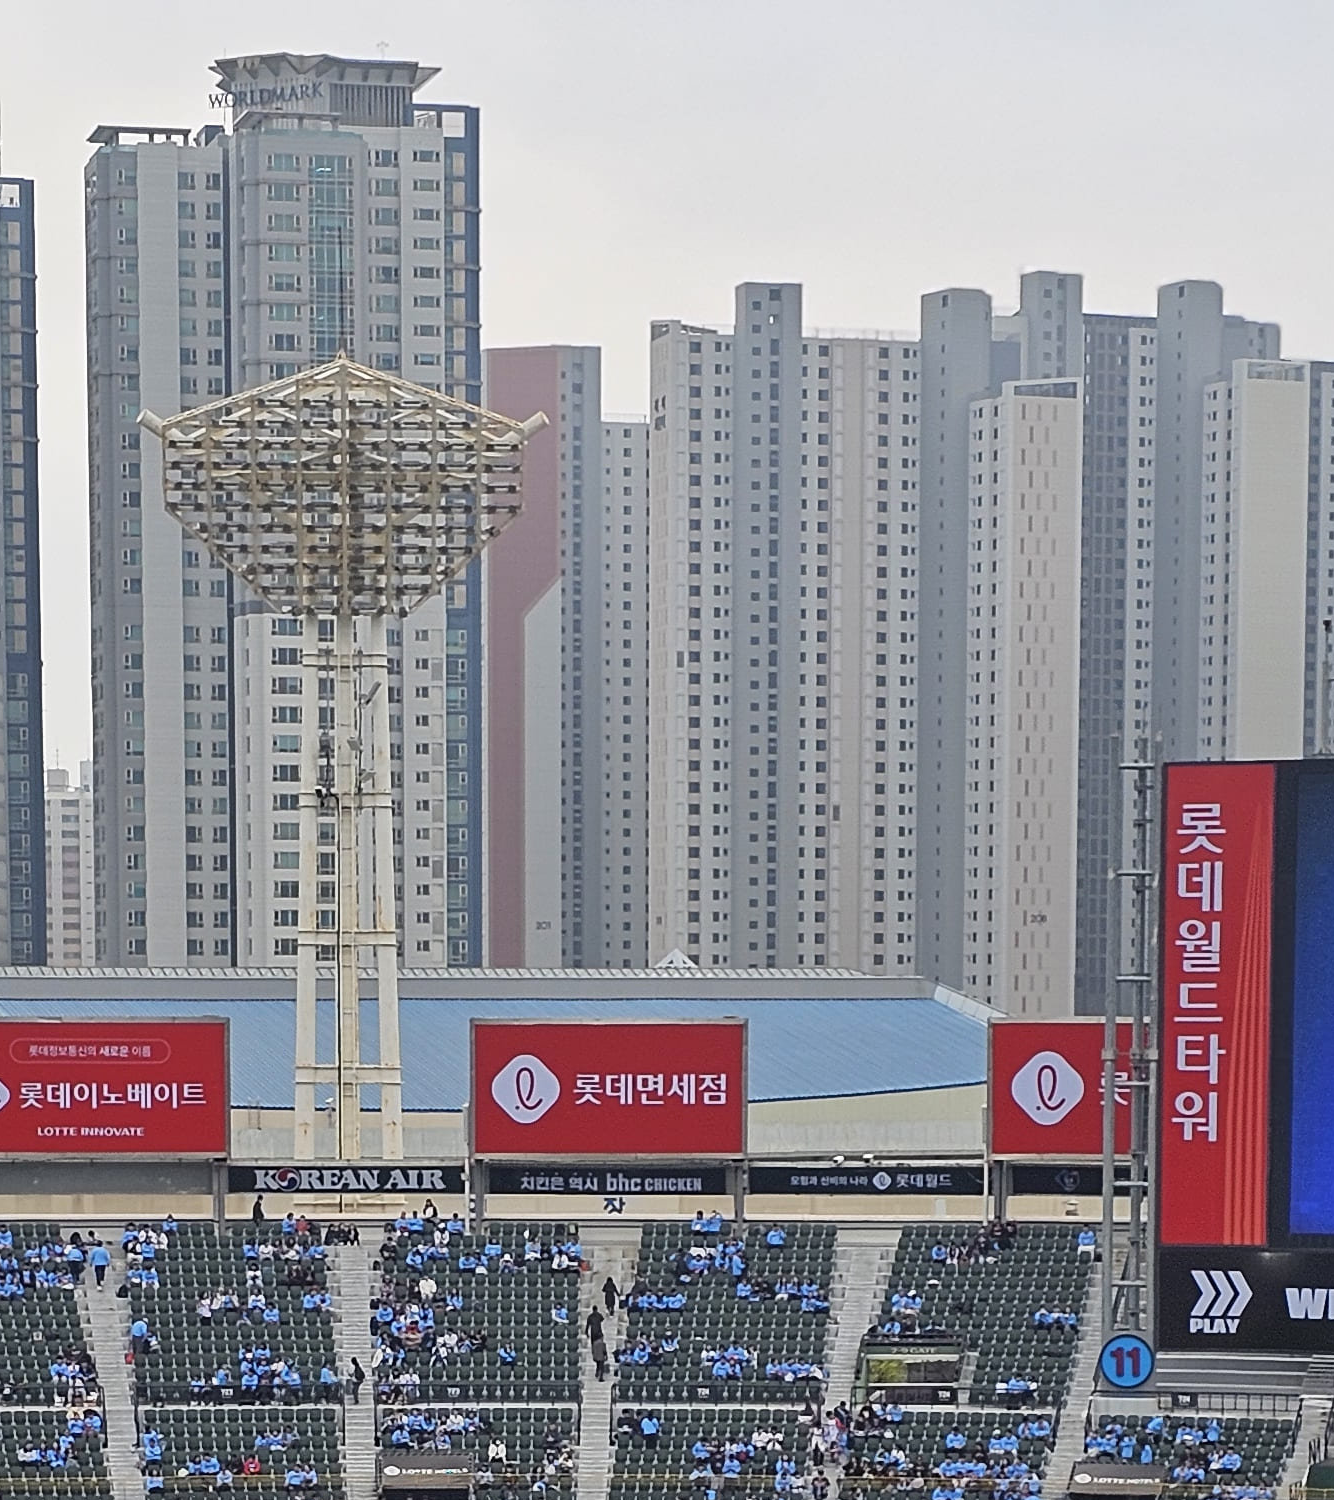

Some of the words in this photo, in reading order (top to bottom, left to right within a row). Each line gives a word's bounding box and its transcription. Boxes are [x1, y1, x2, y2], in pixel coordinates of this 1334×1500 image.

[209, 81, 324, 108] WORLDMARK
[1171, 802, 1227, 1142] 롯데월드타워
[99, 1045, 129, 1057] 새로운
[131, 1045, 151, 1057] 이름
[19, 1082, 207, 1109] 롯데이노베이트
[573, 1072, 727, 1106] 롯데면세점
[37, 1127, 78, 1137] LOTTE
[80, 1127, 145, 1137] INNOVATE
[254, 1168, 379, 1192] KOREAN
[385, 1169, 447, 1191] AIR
[520, 1172, 565, 1191] 치킨은
[568, 1172, 598, 1191] 역시
[606, 1173, 641, 1192] bhc
[644, 1177, 702, 1191] CHICKEN
[895, 1173, 953, 1188] 롯데월드
[1189, 1317, 1240, 1334] PLAY
[1110, 1347, 1142, 1378] 11
